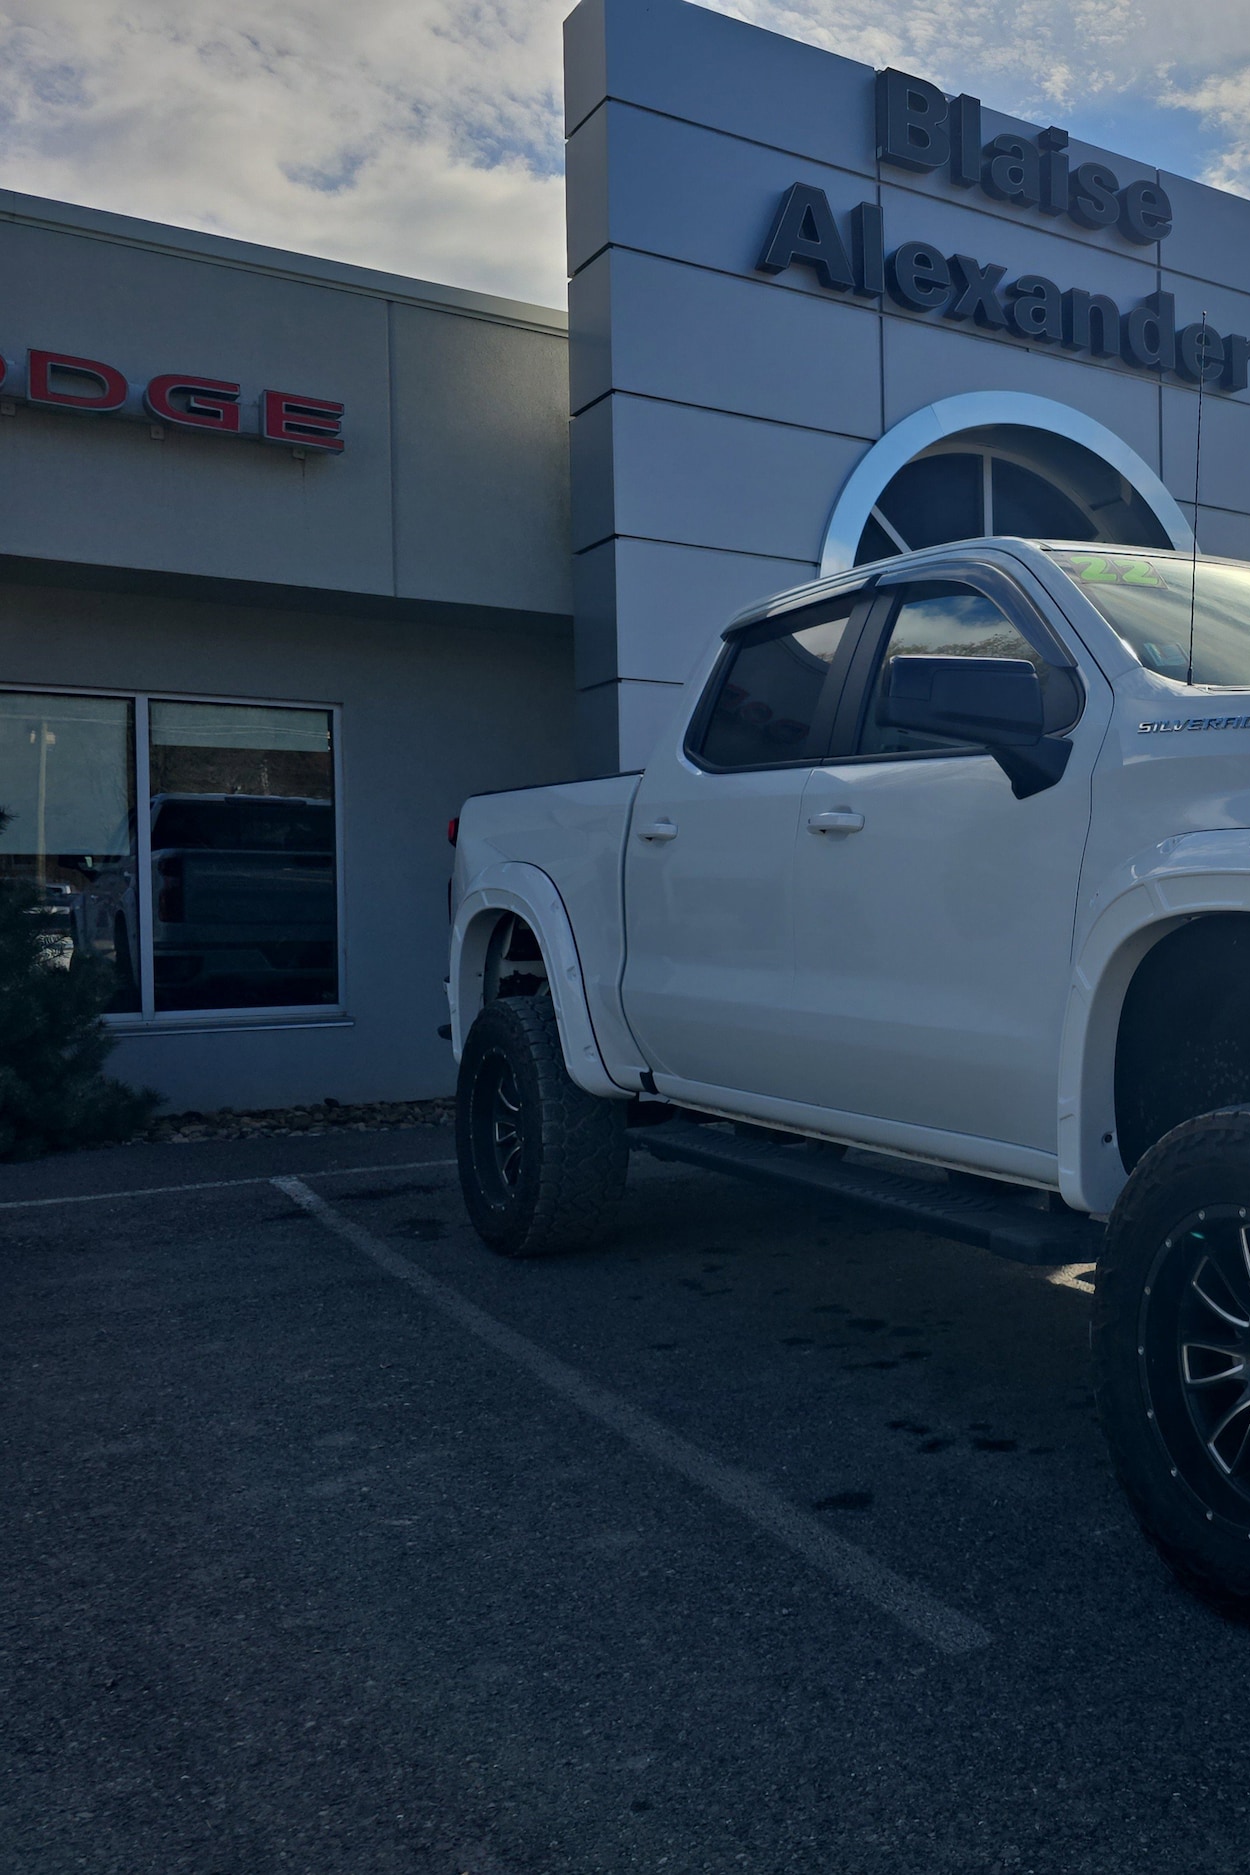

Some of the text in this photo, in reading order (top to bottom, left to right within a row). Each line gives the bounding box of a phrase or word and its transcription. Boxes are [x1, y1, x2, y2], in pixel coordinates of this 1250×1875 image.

[876, 67, 1173, 246] Blaise
[0, 348, 345, 456] DGE
[1070, 556, 1159, 585] 22
